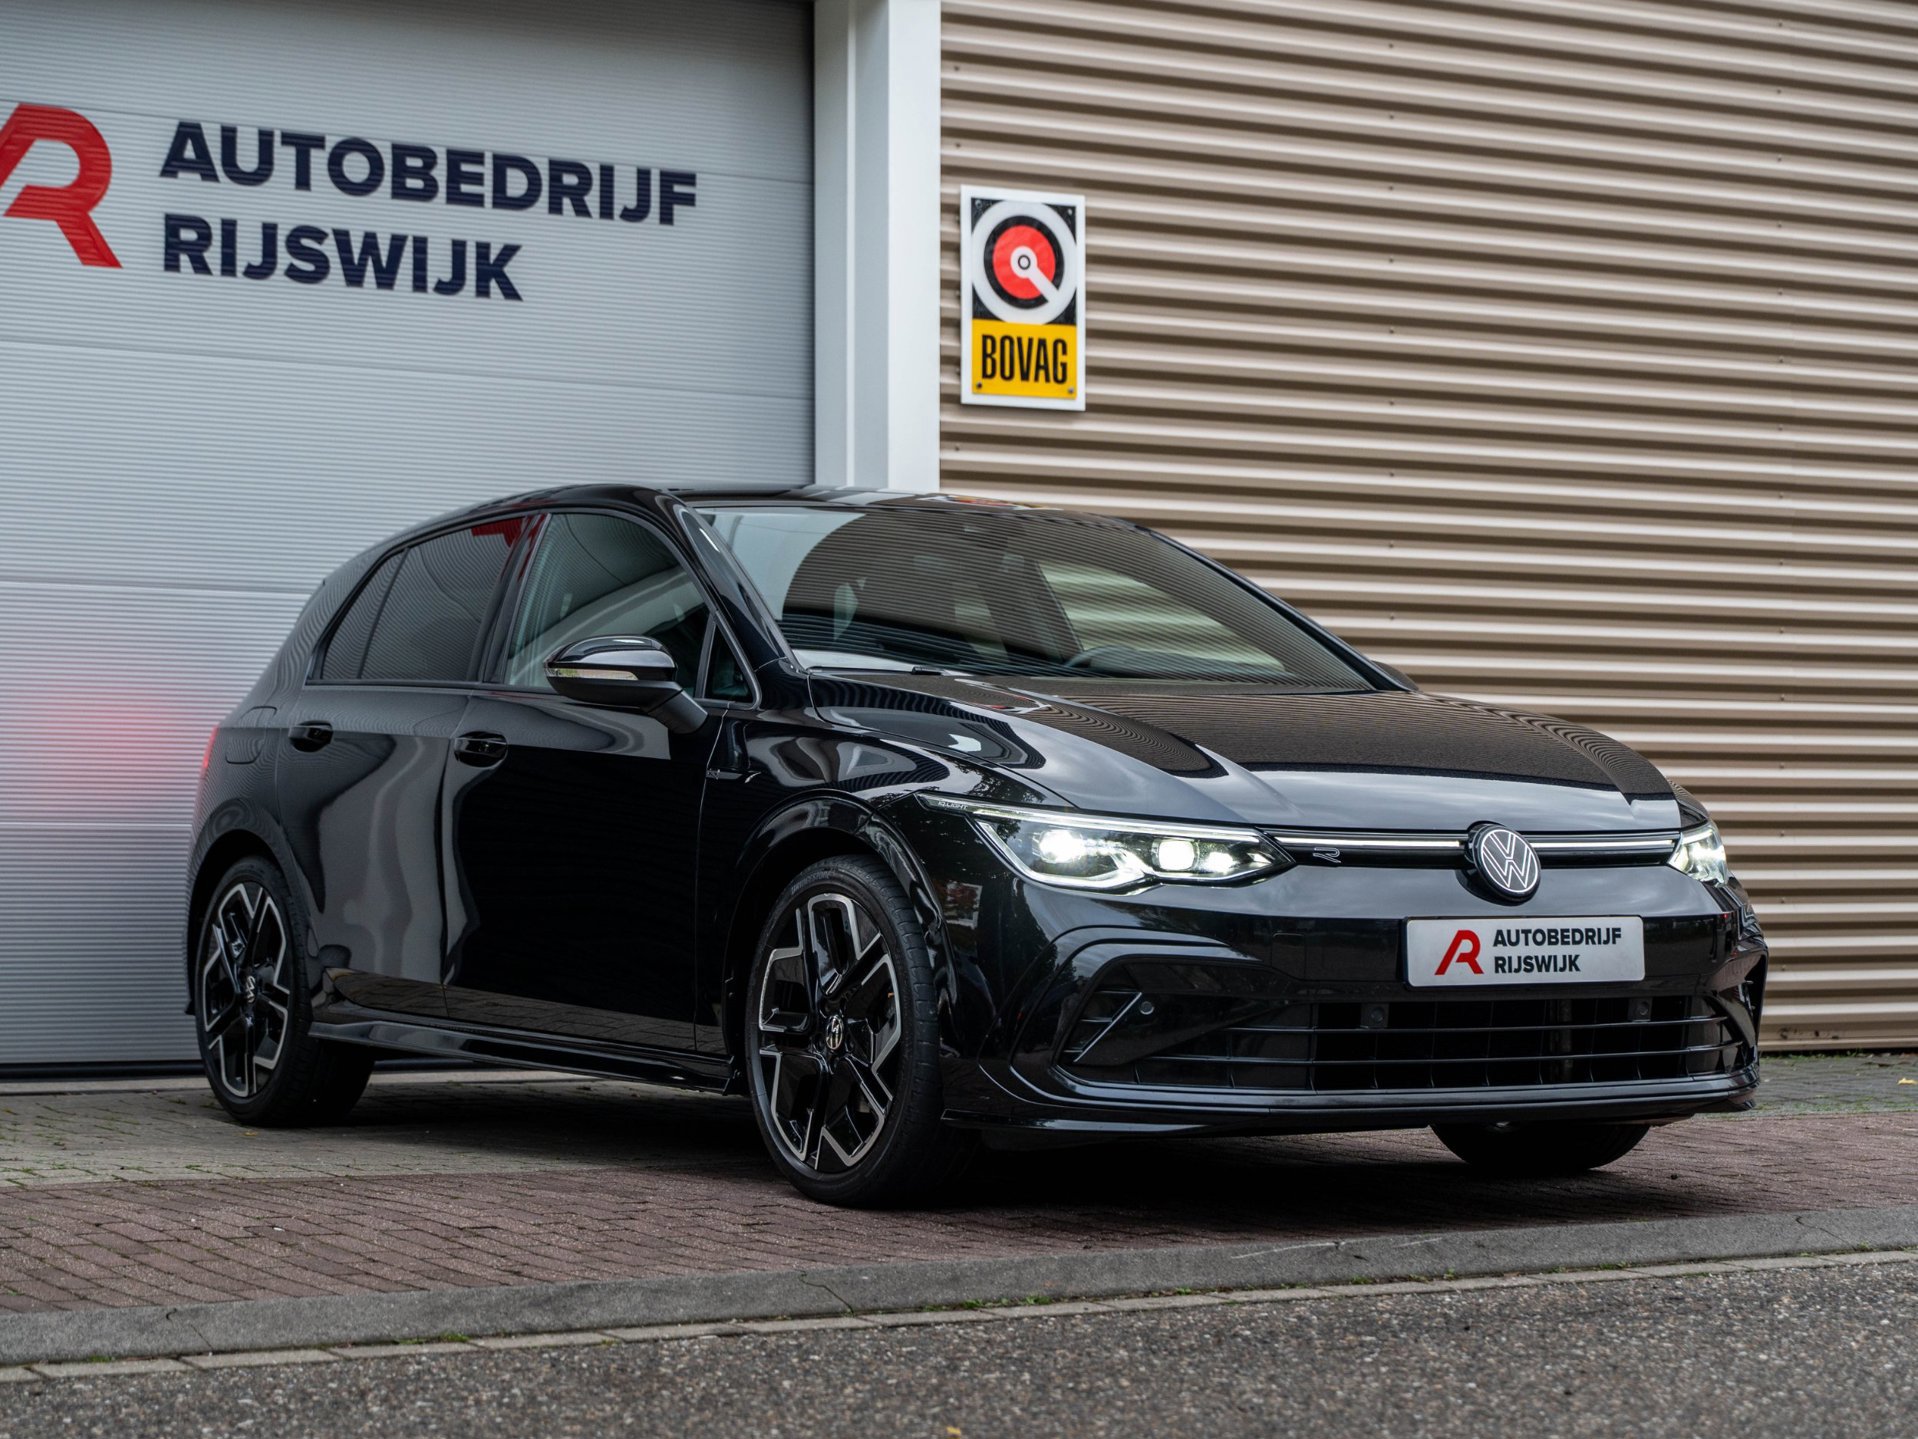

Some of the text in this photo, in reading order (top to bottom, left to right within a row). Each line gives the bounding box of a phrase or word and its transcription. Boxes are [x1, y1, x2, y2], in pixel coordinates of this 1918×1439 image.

[160, 121, 697, 226] AUTOBEDRIJF
[163, 213, 523, 302] RIJSWIJK
[981, 333, 1068, 385] BOVAG
[1492, 927, 1622, 948] AUTOBEDRIJF
[1494, 954, 1581, 974] RIJSWIJK
